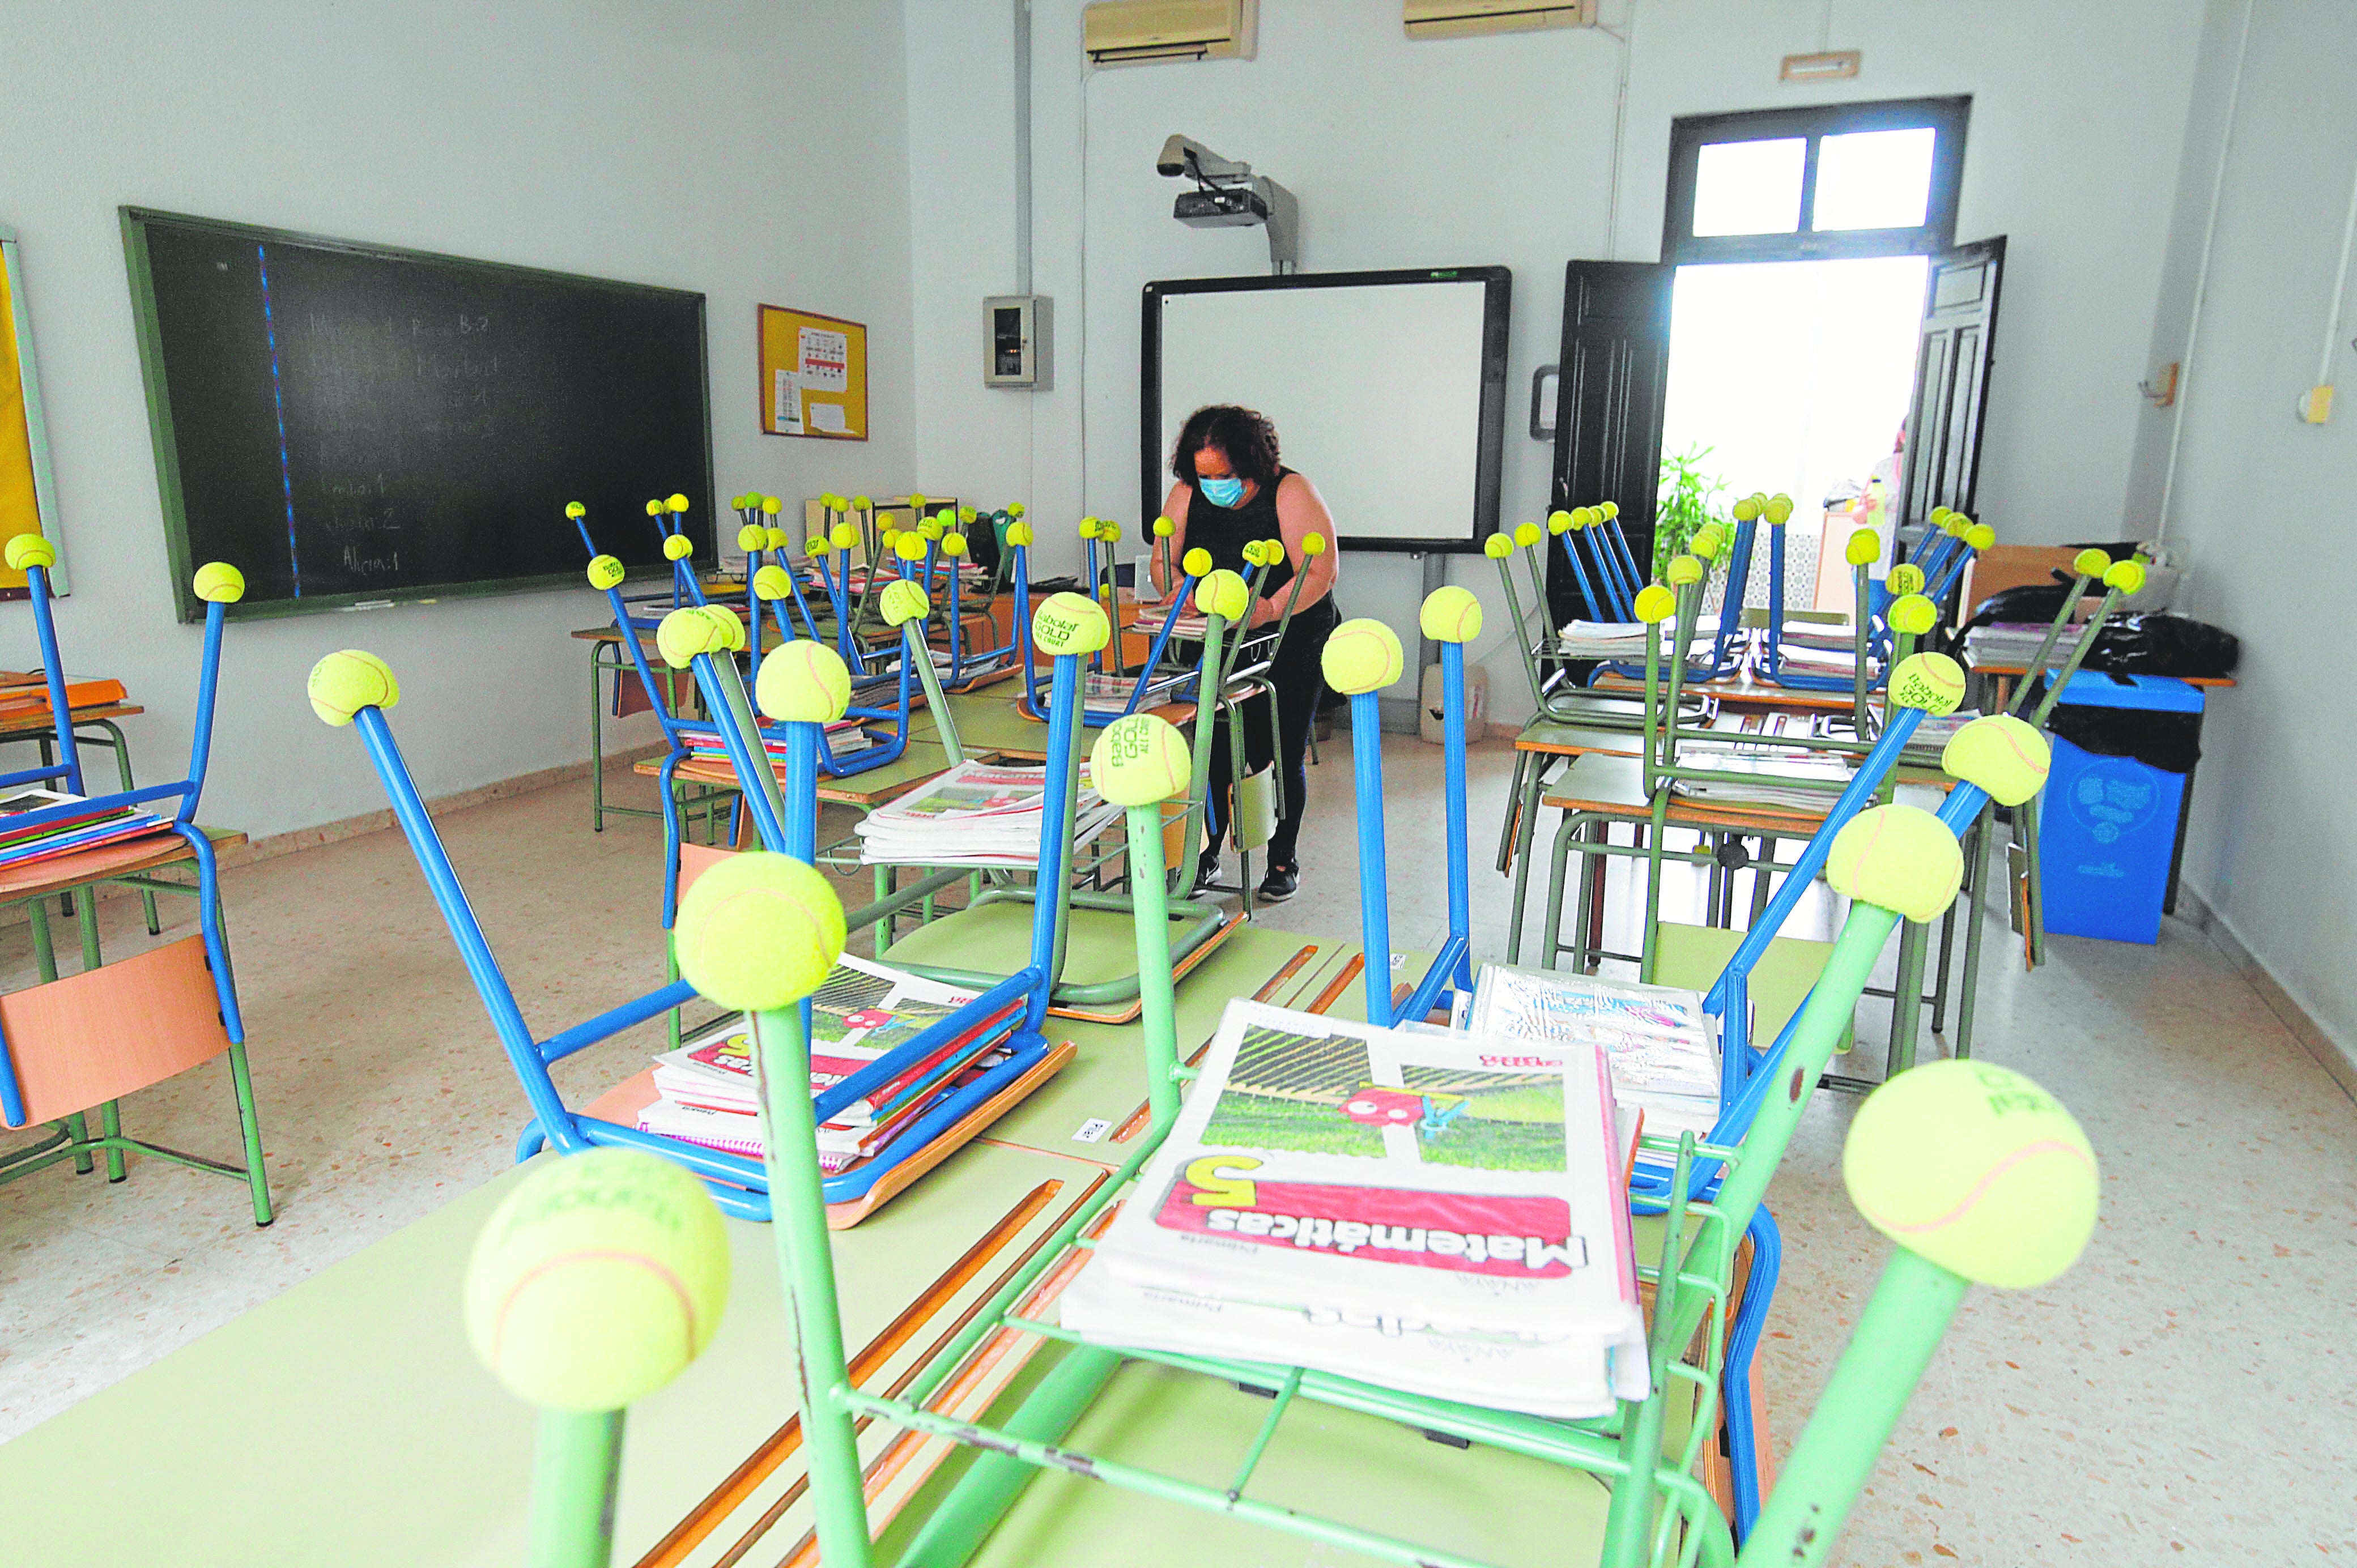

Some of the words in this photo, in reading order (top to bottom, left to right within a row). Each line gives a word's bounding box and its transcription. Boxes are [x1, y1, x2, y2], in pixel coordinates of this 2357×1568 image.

[1035, 621, 1070, 641] GOLD
[1044, 636, 1064, 647] COURT
[1185, 1154, 1264, 1207] 5
[1180, 1234, 1258, 1254] Primaria
[1206, 1208, 1588, 1269] Matemáticas
[1456, 1273, 1537, 1297] ANAYA
